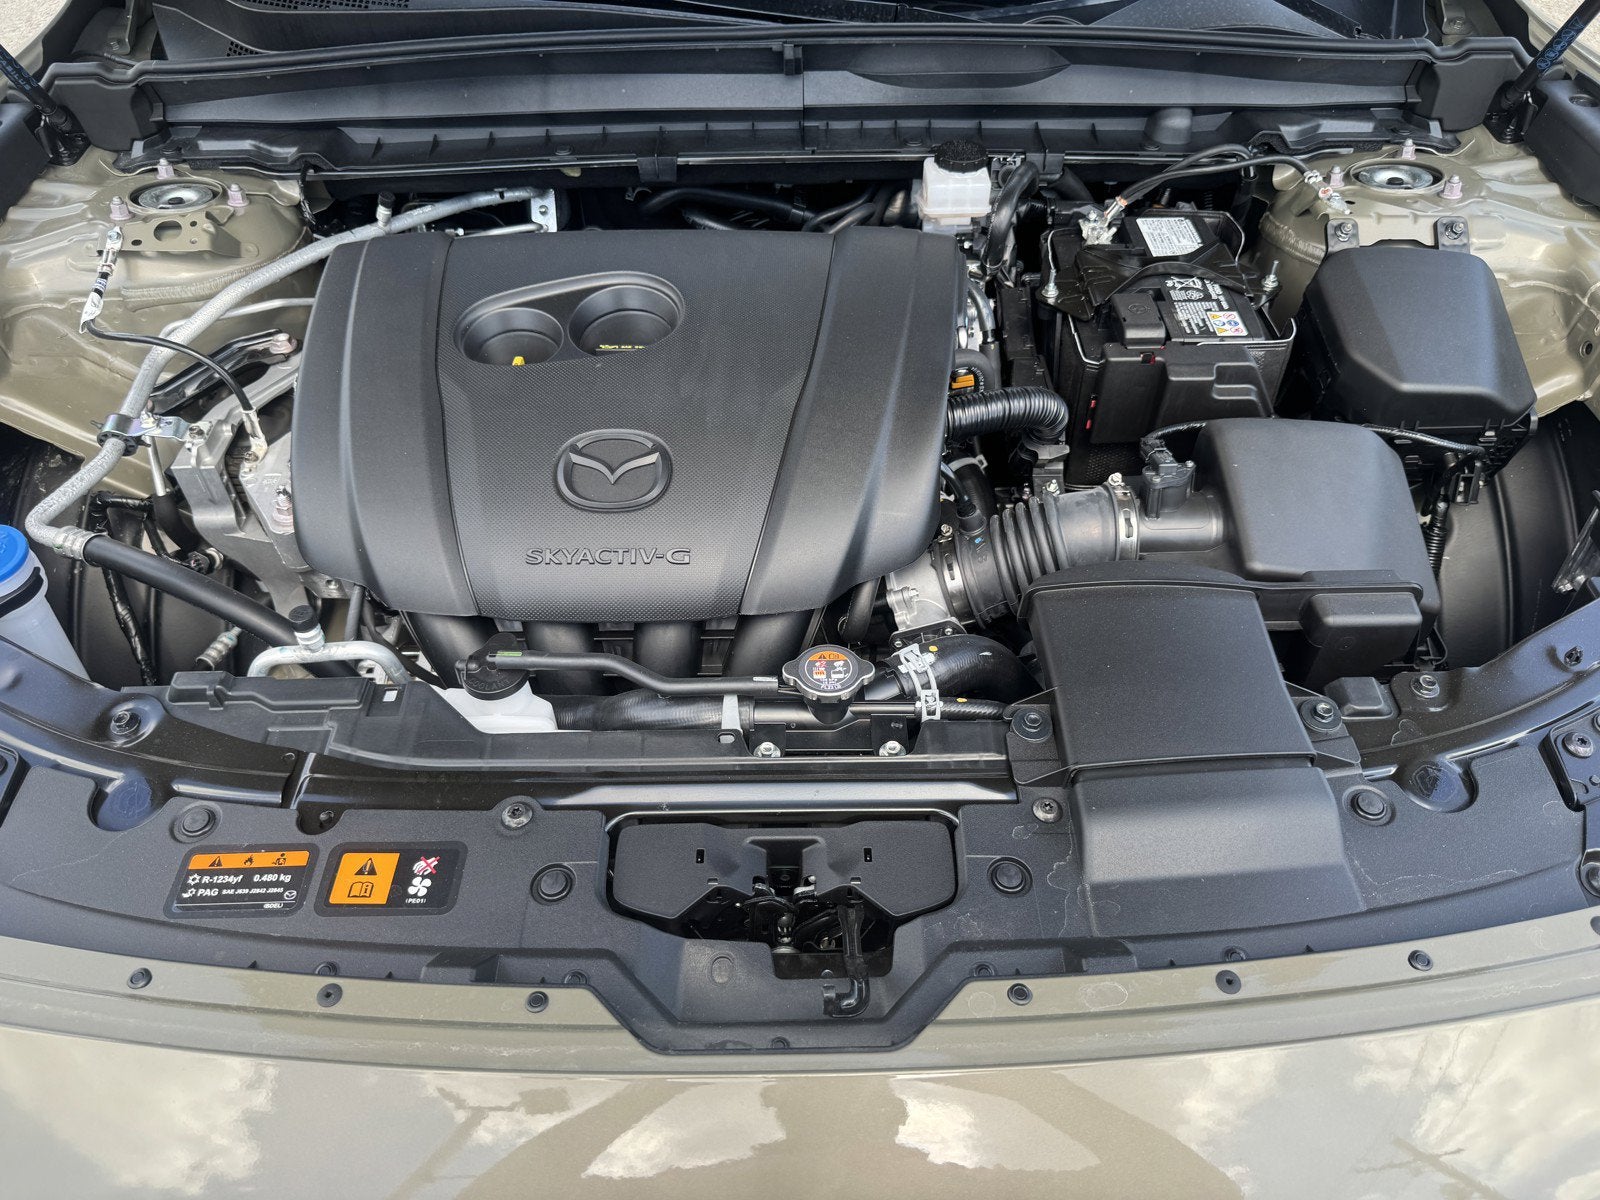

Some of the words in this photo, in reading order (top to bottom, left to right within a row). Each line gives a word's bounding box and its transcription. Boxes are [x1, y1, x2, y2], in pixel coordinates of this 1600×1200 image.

[525, 547, 691, 566] SKYACTIV-G
[201, 874, 243, 884] R-1234yf
[253, 873, 279, 883] 0.480
[279, 873, 292, 883] kg
[197, 888, 219, 897] PAG
